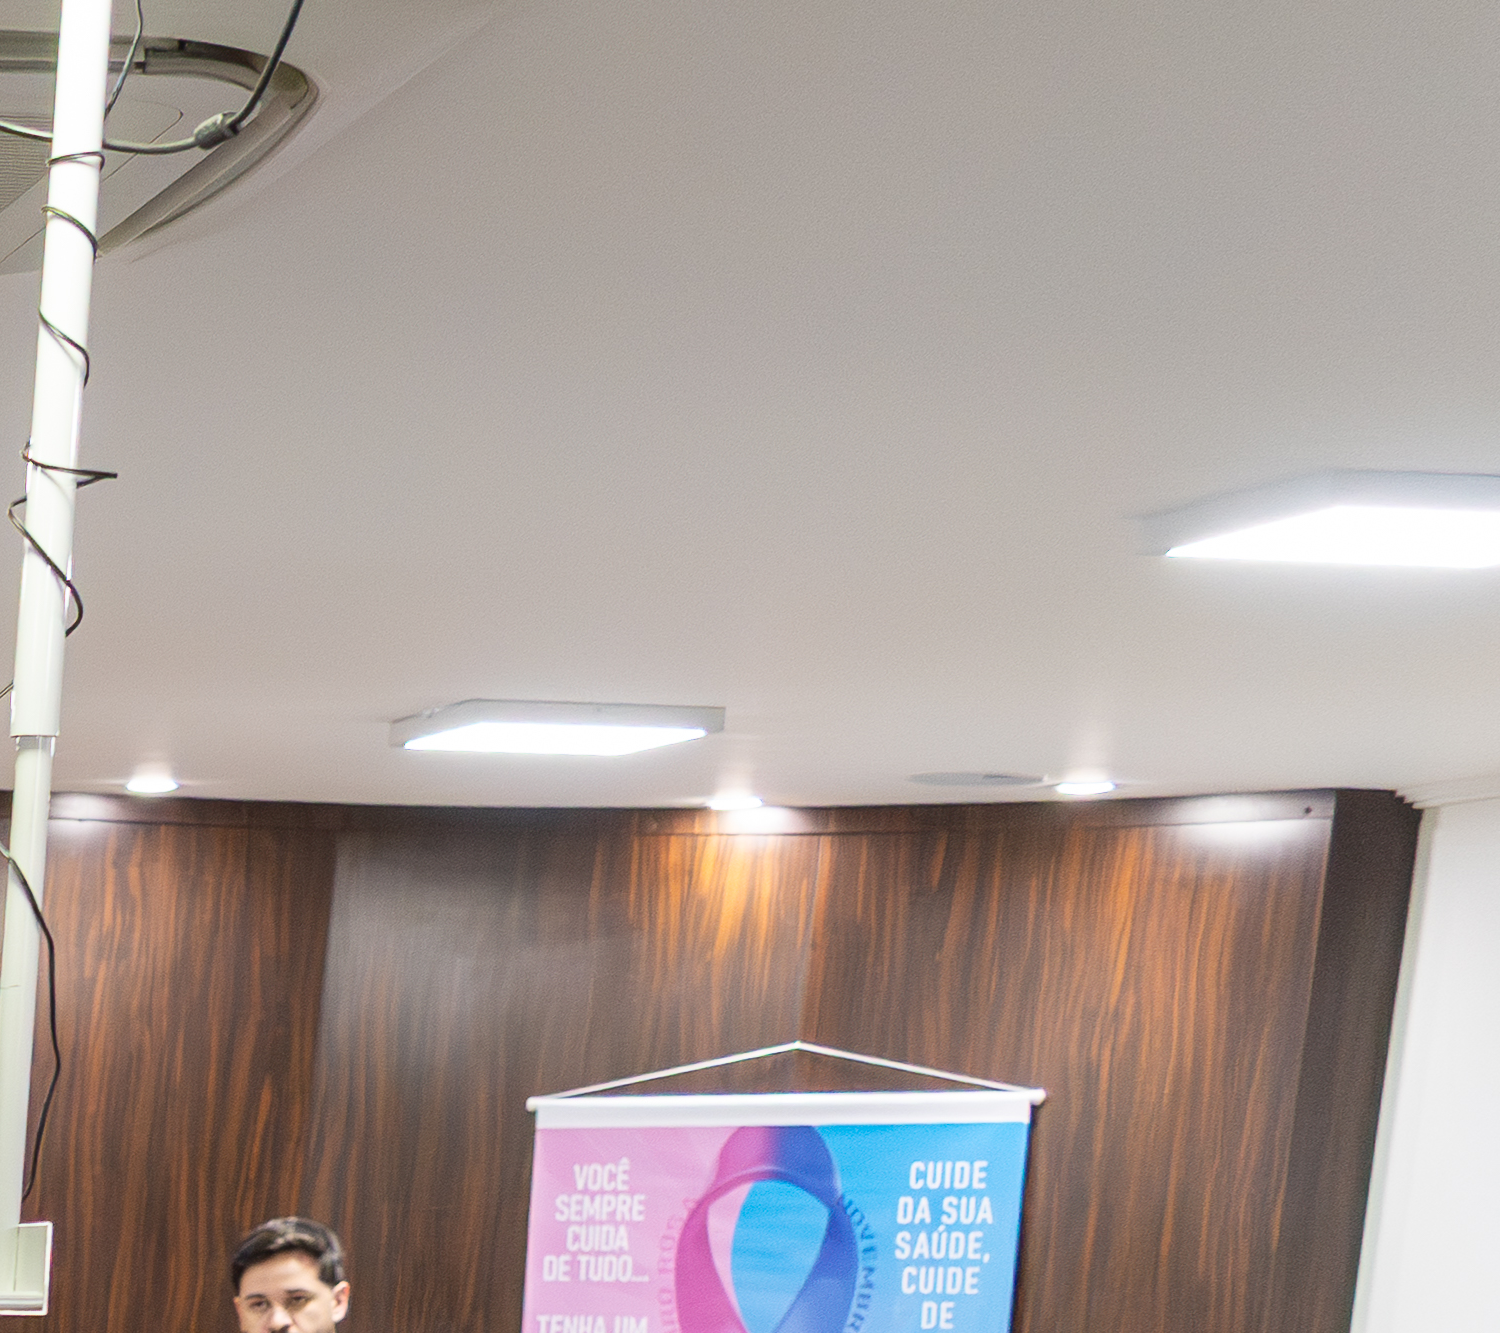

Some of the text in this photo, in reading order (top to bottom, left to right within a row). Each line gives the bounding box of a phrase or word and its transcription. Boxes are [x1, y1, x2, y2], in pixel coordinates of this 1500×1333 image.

[573, 1156, 631, 1191] VOCÊ
[909, 1160, 988, 1190] CUIDE
[555, 1194, 646, 1222] SEMPRE
[896, 1196, 993, 1225] DA SUA
[566, 1225, 629, 1252] CUIDA
[894, 1225, 990, 1263] SAÚDE,
[543, 1254, 571, 1282] DE
[901, 1266, 981, 1295] CUIDE
[921, 1301, 954, 1330] DE
